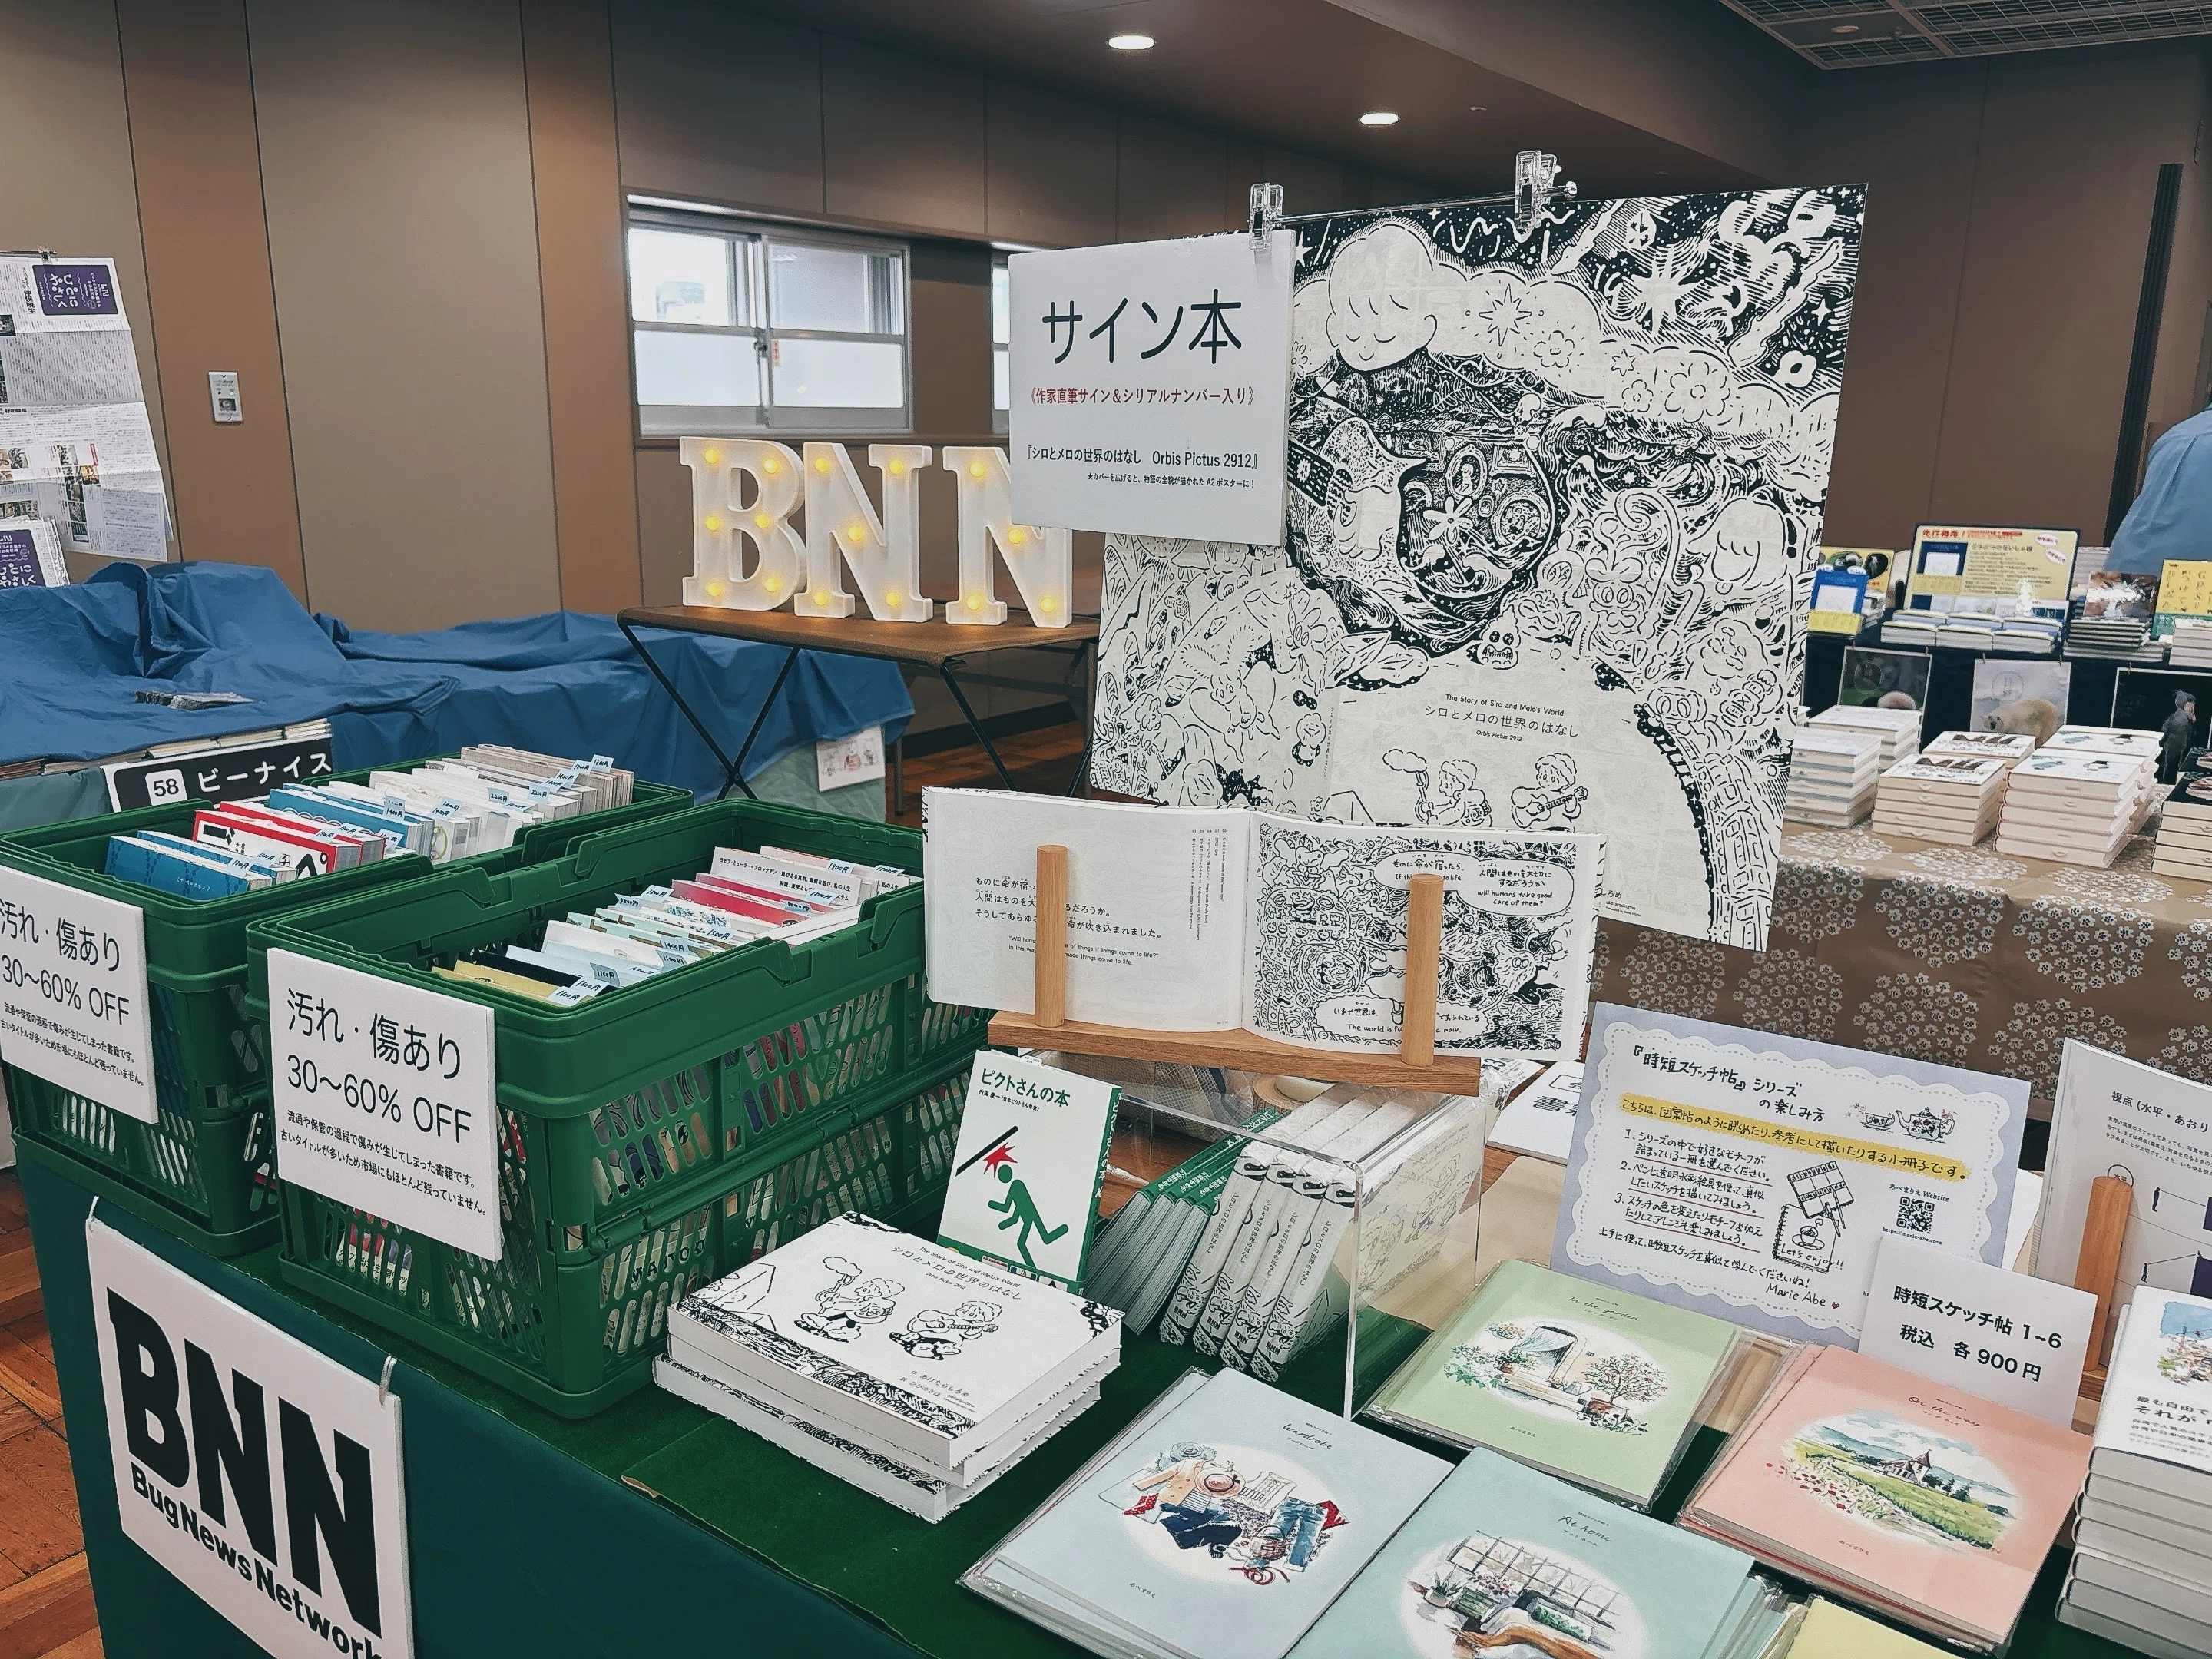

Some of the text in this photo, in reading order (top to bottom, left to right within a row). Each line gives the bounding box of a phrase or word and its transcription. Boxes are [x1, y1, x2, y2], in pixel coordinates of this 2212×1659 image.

[1041, 288, 1243, 365] サイン本
[1028, 445, 1142, 465] 『シロとメロの世界のはなし
[1152, 451, 1181, 466] Orbis
[1184, 452, 1220, 468] Pictus
[1206, 478, 1216, 487] A2
[679, 435, 1073, 629] BNN
[1445, 694, 1458, 702] The
[1460, 696, 1478, 706] Story
[1490, 700, 1503, 708] Siro
[1543, 707, 1565, 717] World
[1424, 704, 1579, 738] シロとメロの世界のはなし
[154, 751, 333, 797] 58 ビーナイス
[0, 899, 120, 972] 汚れ・傷あり
[707, 928, 730, 940] 1500円
[88, 986, 130, 1026] OFF
[286, 988, 462, 1080] 汚れ・傷あり
[1346, 1023, 1362, 1031] The
[1363, 1024, 1384, 1032] world
[981, 1067, 1071, 1108] ピクトさんの本
[1753, 1078, 1803, 1098] シリーズ
[2111, 1091, 2134, 1108] 視点
[412, 1095, 472, 1144] OFF
[1758, 1098, 1826, 1123] の楽しみ方
[1922, 1190, 1950, 1203] Website
[1779, 1242, 1803, 1259] Let's
[890, 1246, 1022, 1300] シロとメロの世界のはなし
[919, 1247, 931, 1255] The
[932, 1251, 947, 1262] Story
[1001, 1278, 1022, 1288] World
[1765, 1283, 1827, 1308] Marie Abe
[1172, 1306, 1187, 1320] BNN
[1207, 1316, 1221, 1330] BNN
[1892, 1285, 2014, 1336] 時短スケッチ帖
[1233, 1330, 1249, 1344] BNN
[1265, 1341, 1281, 1356] BNN
[1899, 1323, 2042, 1382] 税込 各 900 円
[1908, 1396, 1926, 1406] On
[1283, 1423, 1334, 1450] Wardrobe
[105, 1286, 383, 1639] BNN
[130, 1460, 180, 1529] Bug
[180, 1501, 253, 1583] News
[1579, 1525, 1613, 1542] home
